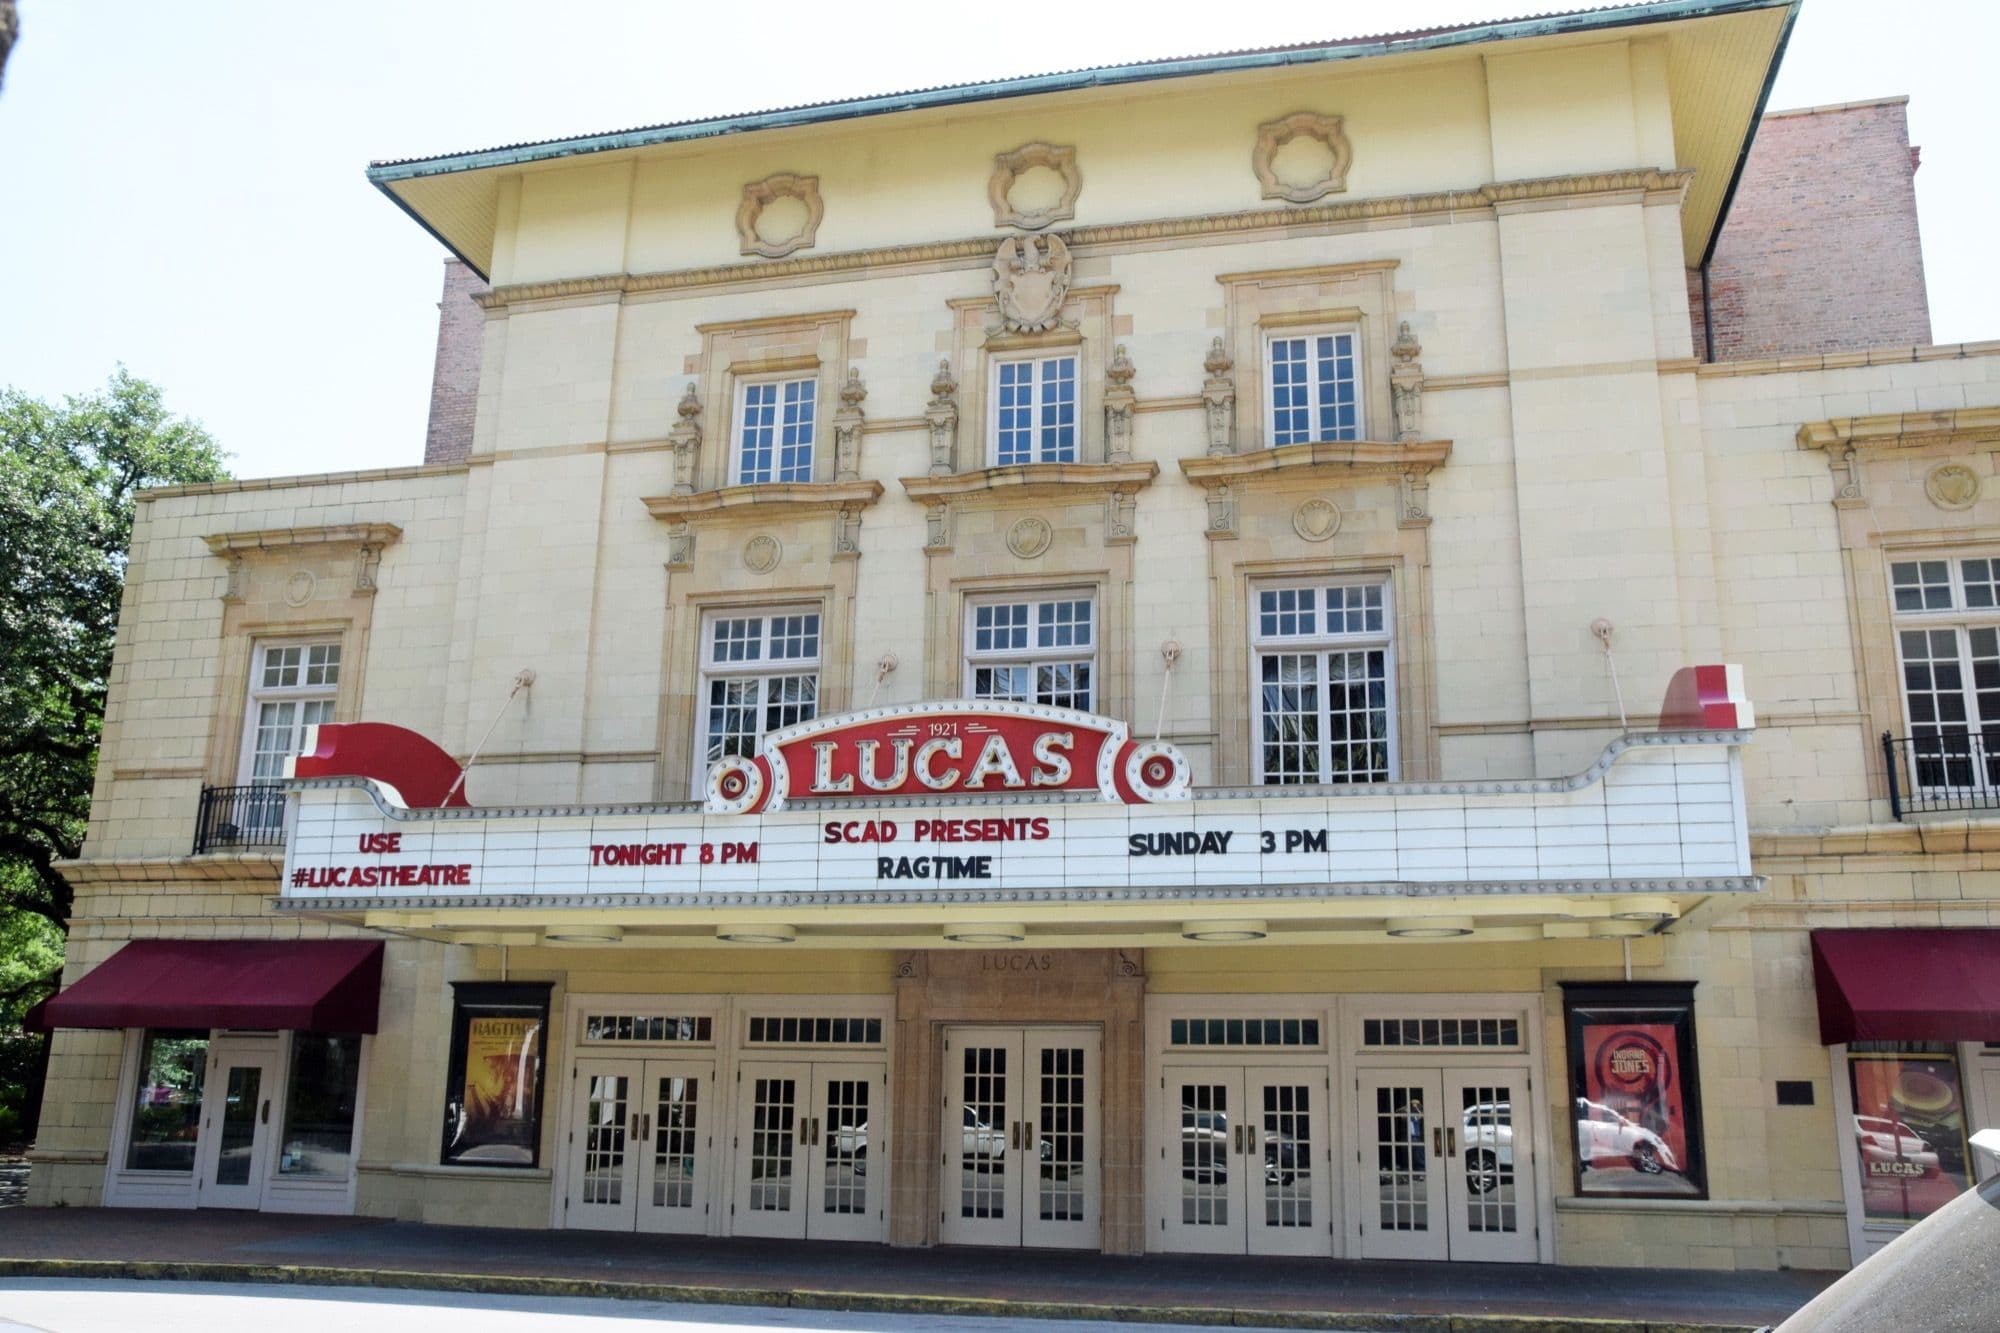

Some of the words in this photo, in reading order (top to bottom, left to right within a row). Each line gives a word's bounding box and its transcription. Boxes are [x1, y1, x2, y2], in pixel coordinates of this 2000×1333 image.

[928, 723, 957, 736] 1921
[809, 731, 1074, 793] LUCAS
[824, 821, 897, 843] SCAD
[914, 817, 1050, 842] PRESENTS
[359, 833, 401, 853] USE
[591, 843, 687, 866] TONIGHT
[700, 843, 714, 864] 8
[721, 842, 758, 864] PM
[1128, 830, 1233, 856] SUNDAY
[1261, 830, 1277, 854] 3
[1286, 829, 1327, 854] PM
[292, 864, 471, 888] #LUCASTHEATRE
[877, 856, 992, 879] RAGTIME
[981, 954, 1051, 971] LUCAS
[1611, 1060, 1649, 1073] JONES
[1870, 1162, 1924, 1174] LUCAS
